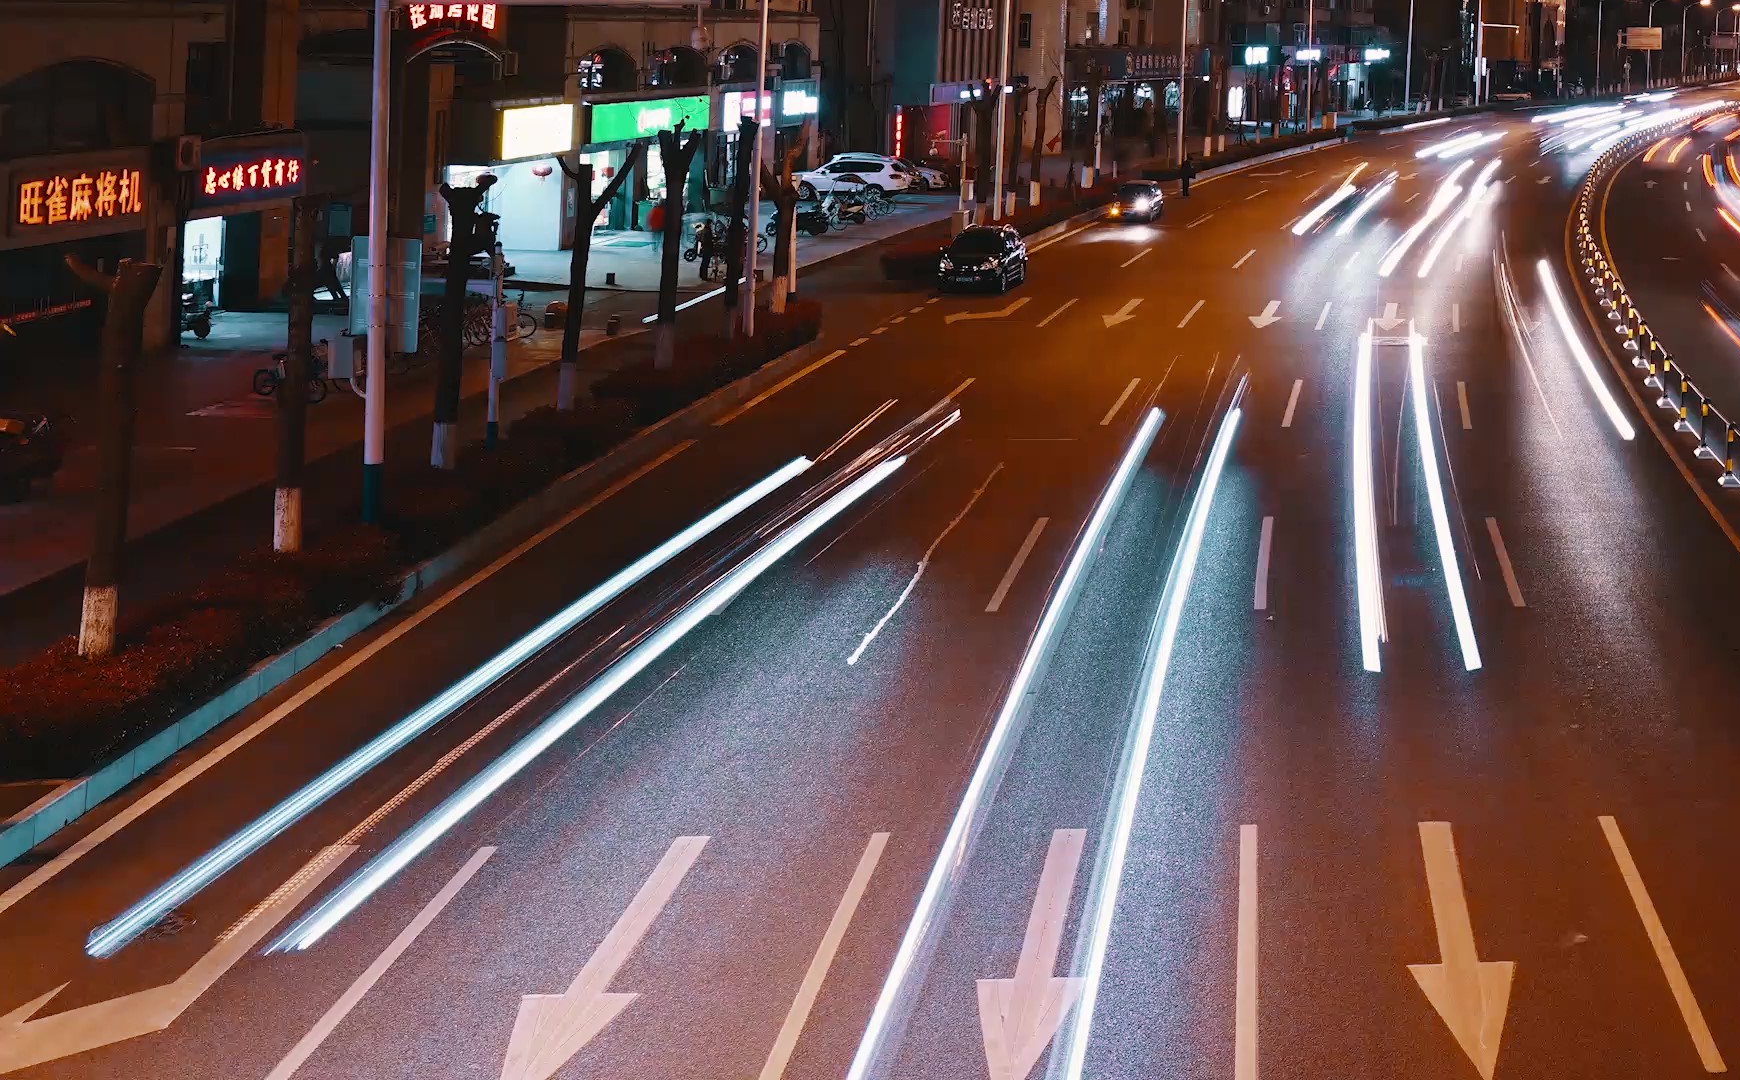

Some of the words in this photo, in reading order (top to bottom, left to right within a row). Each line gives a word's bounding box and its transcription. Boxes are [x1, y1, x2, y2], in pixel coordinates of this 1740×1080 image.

[19, 168, 143, 225] 旺雀麻将机
